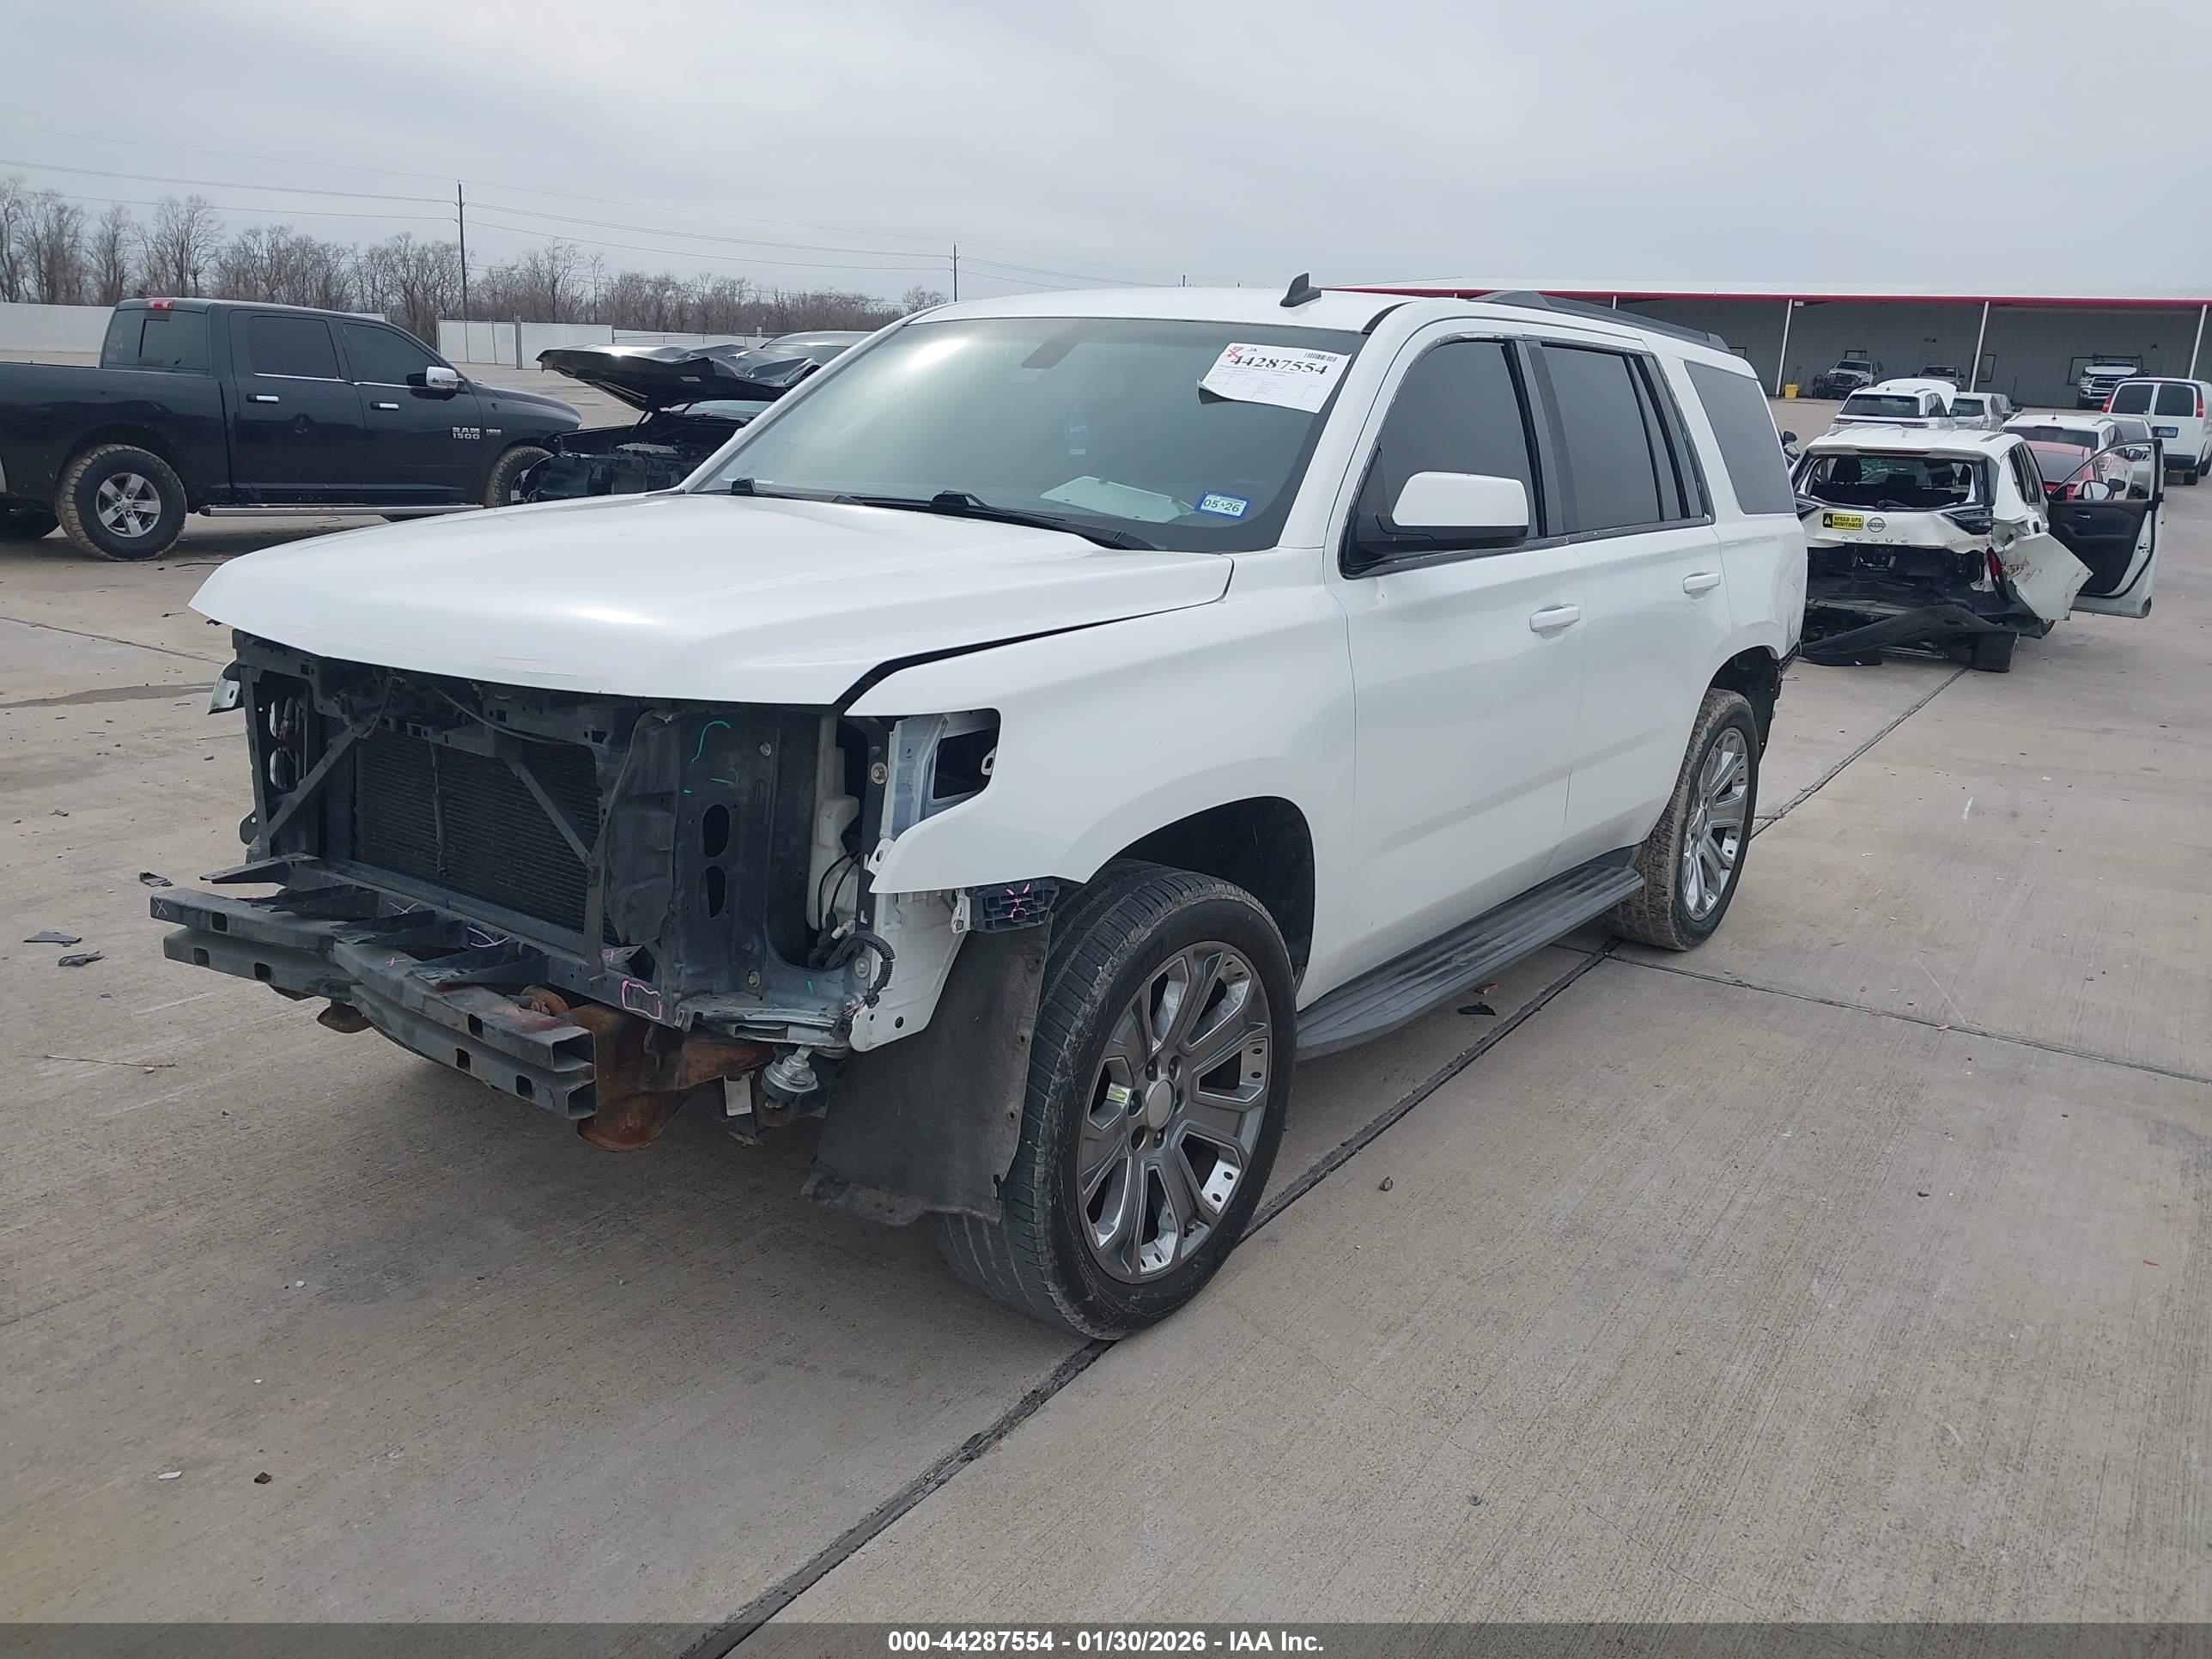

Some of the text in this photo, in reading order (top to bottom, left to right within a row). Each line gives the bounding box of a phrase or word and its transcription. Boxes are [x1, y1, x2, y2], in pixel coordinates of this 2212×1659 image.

[1230, 356, 1328, 375] 44287554
[1203, 499, 1219, 508] 05
[1224, 502, 1241, 512] 26
